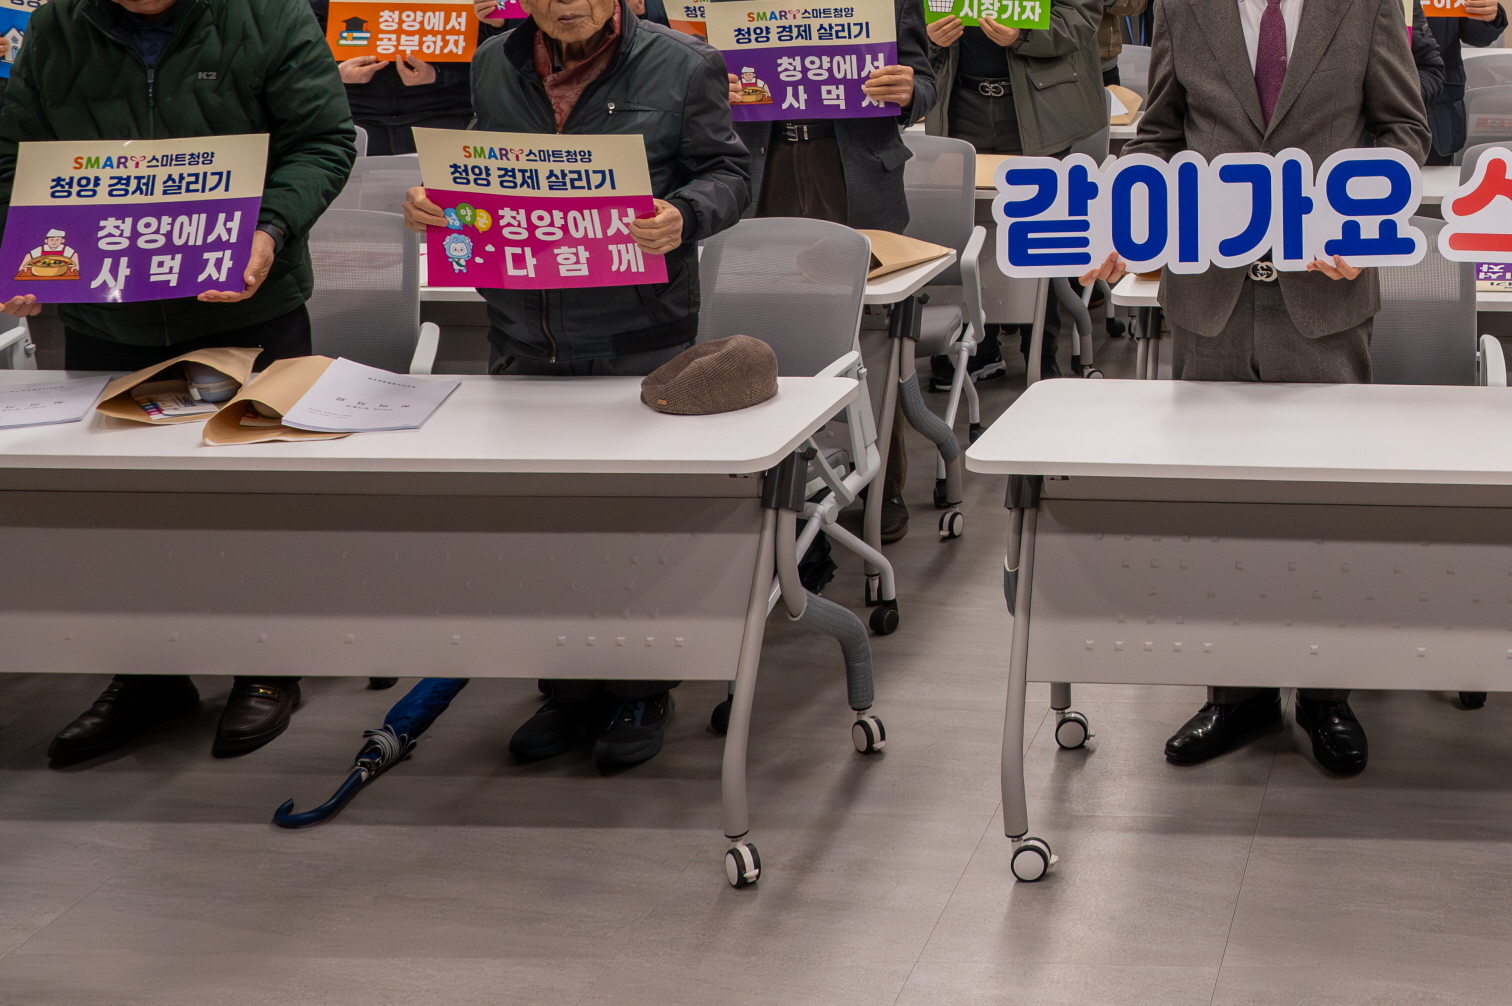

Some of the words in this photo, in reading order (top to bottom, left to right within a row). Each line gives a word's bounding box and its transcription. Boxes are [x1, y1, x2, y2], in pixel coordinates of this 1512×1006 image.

[378, 10, 466, 32] 청양에서
[734, 26, 771, 44] 청양
[776, 24, 812, 42] 경제
[817, 21, 870, 40] 살리기
[376, 34, 466, 54] 공부하자
[198, 72, 218, 80] K2
[50, 176, 101, 199] 청양
[107, 174, 156, 197] 경제
[162, 170, 232, 195] 살리기
[449, 164, 491, 186] 청양
[497, 167, 541, 190] 경제
[546, 169, 617, 190] 살리기
[1003, 161, 1415, 266] 같이가요
[97, 211, 242, 251] 청양에서
